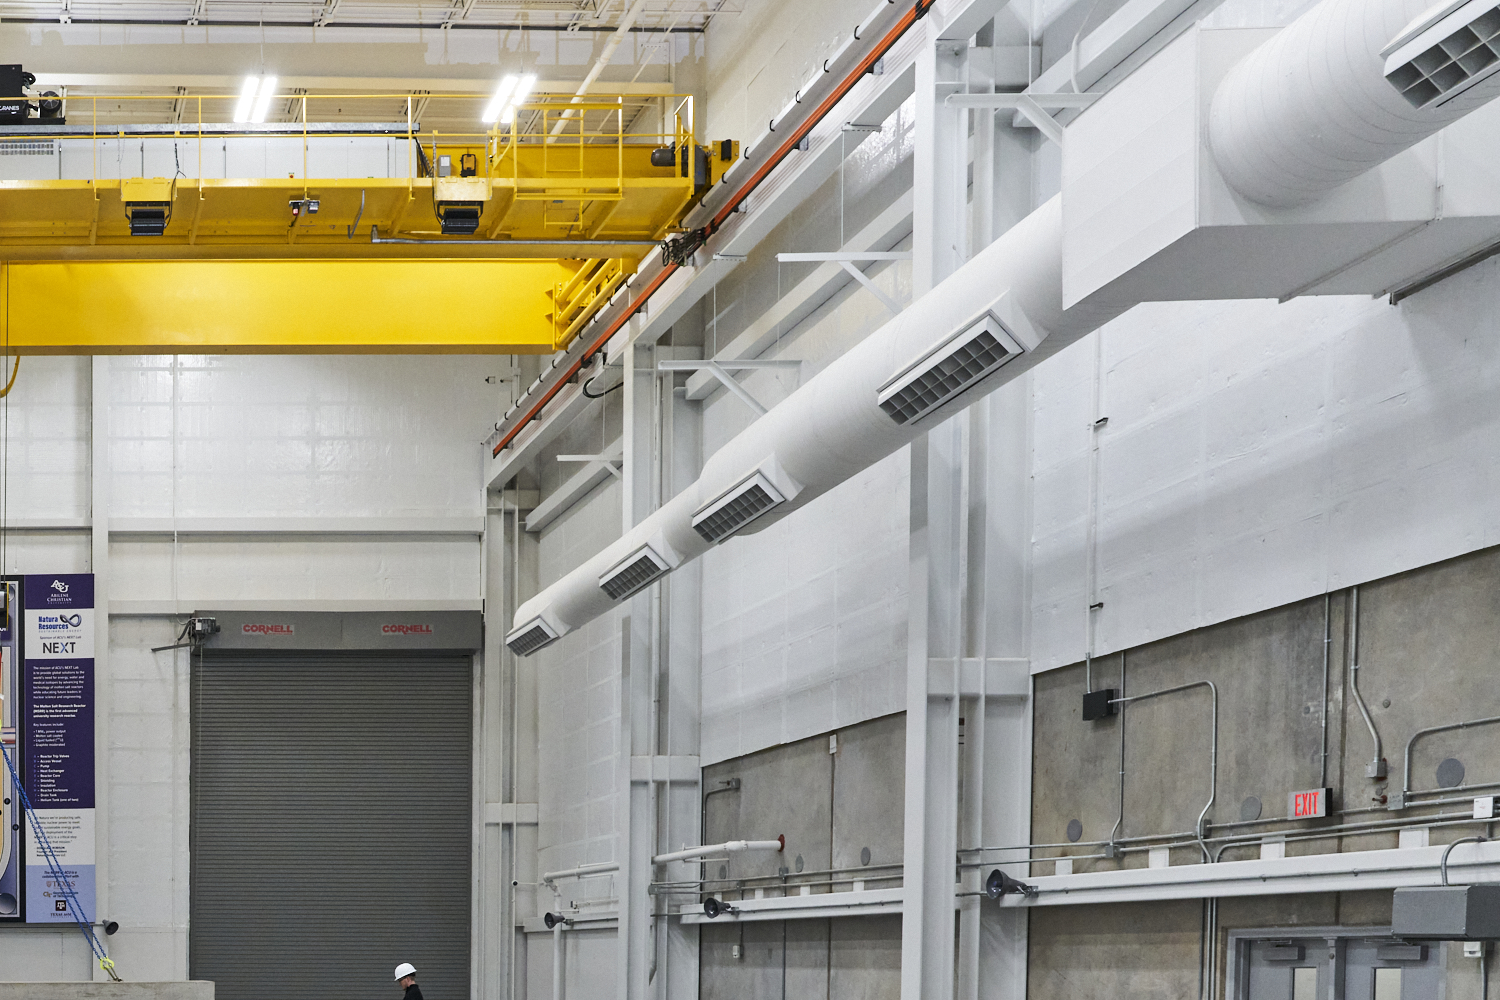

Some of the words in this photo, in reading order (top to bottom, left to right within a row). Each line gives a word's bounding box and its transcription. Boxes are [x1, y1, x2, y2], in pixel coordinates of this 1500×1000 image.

[243, 624, 293, 635] CORNELL
[382, 625, 432, 635] CORNELL
[43, 642, 76, 654] NEXT
[1295, 792, 1319, 816] EXIT
